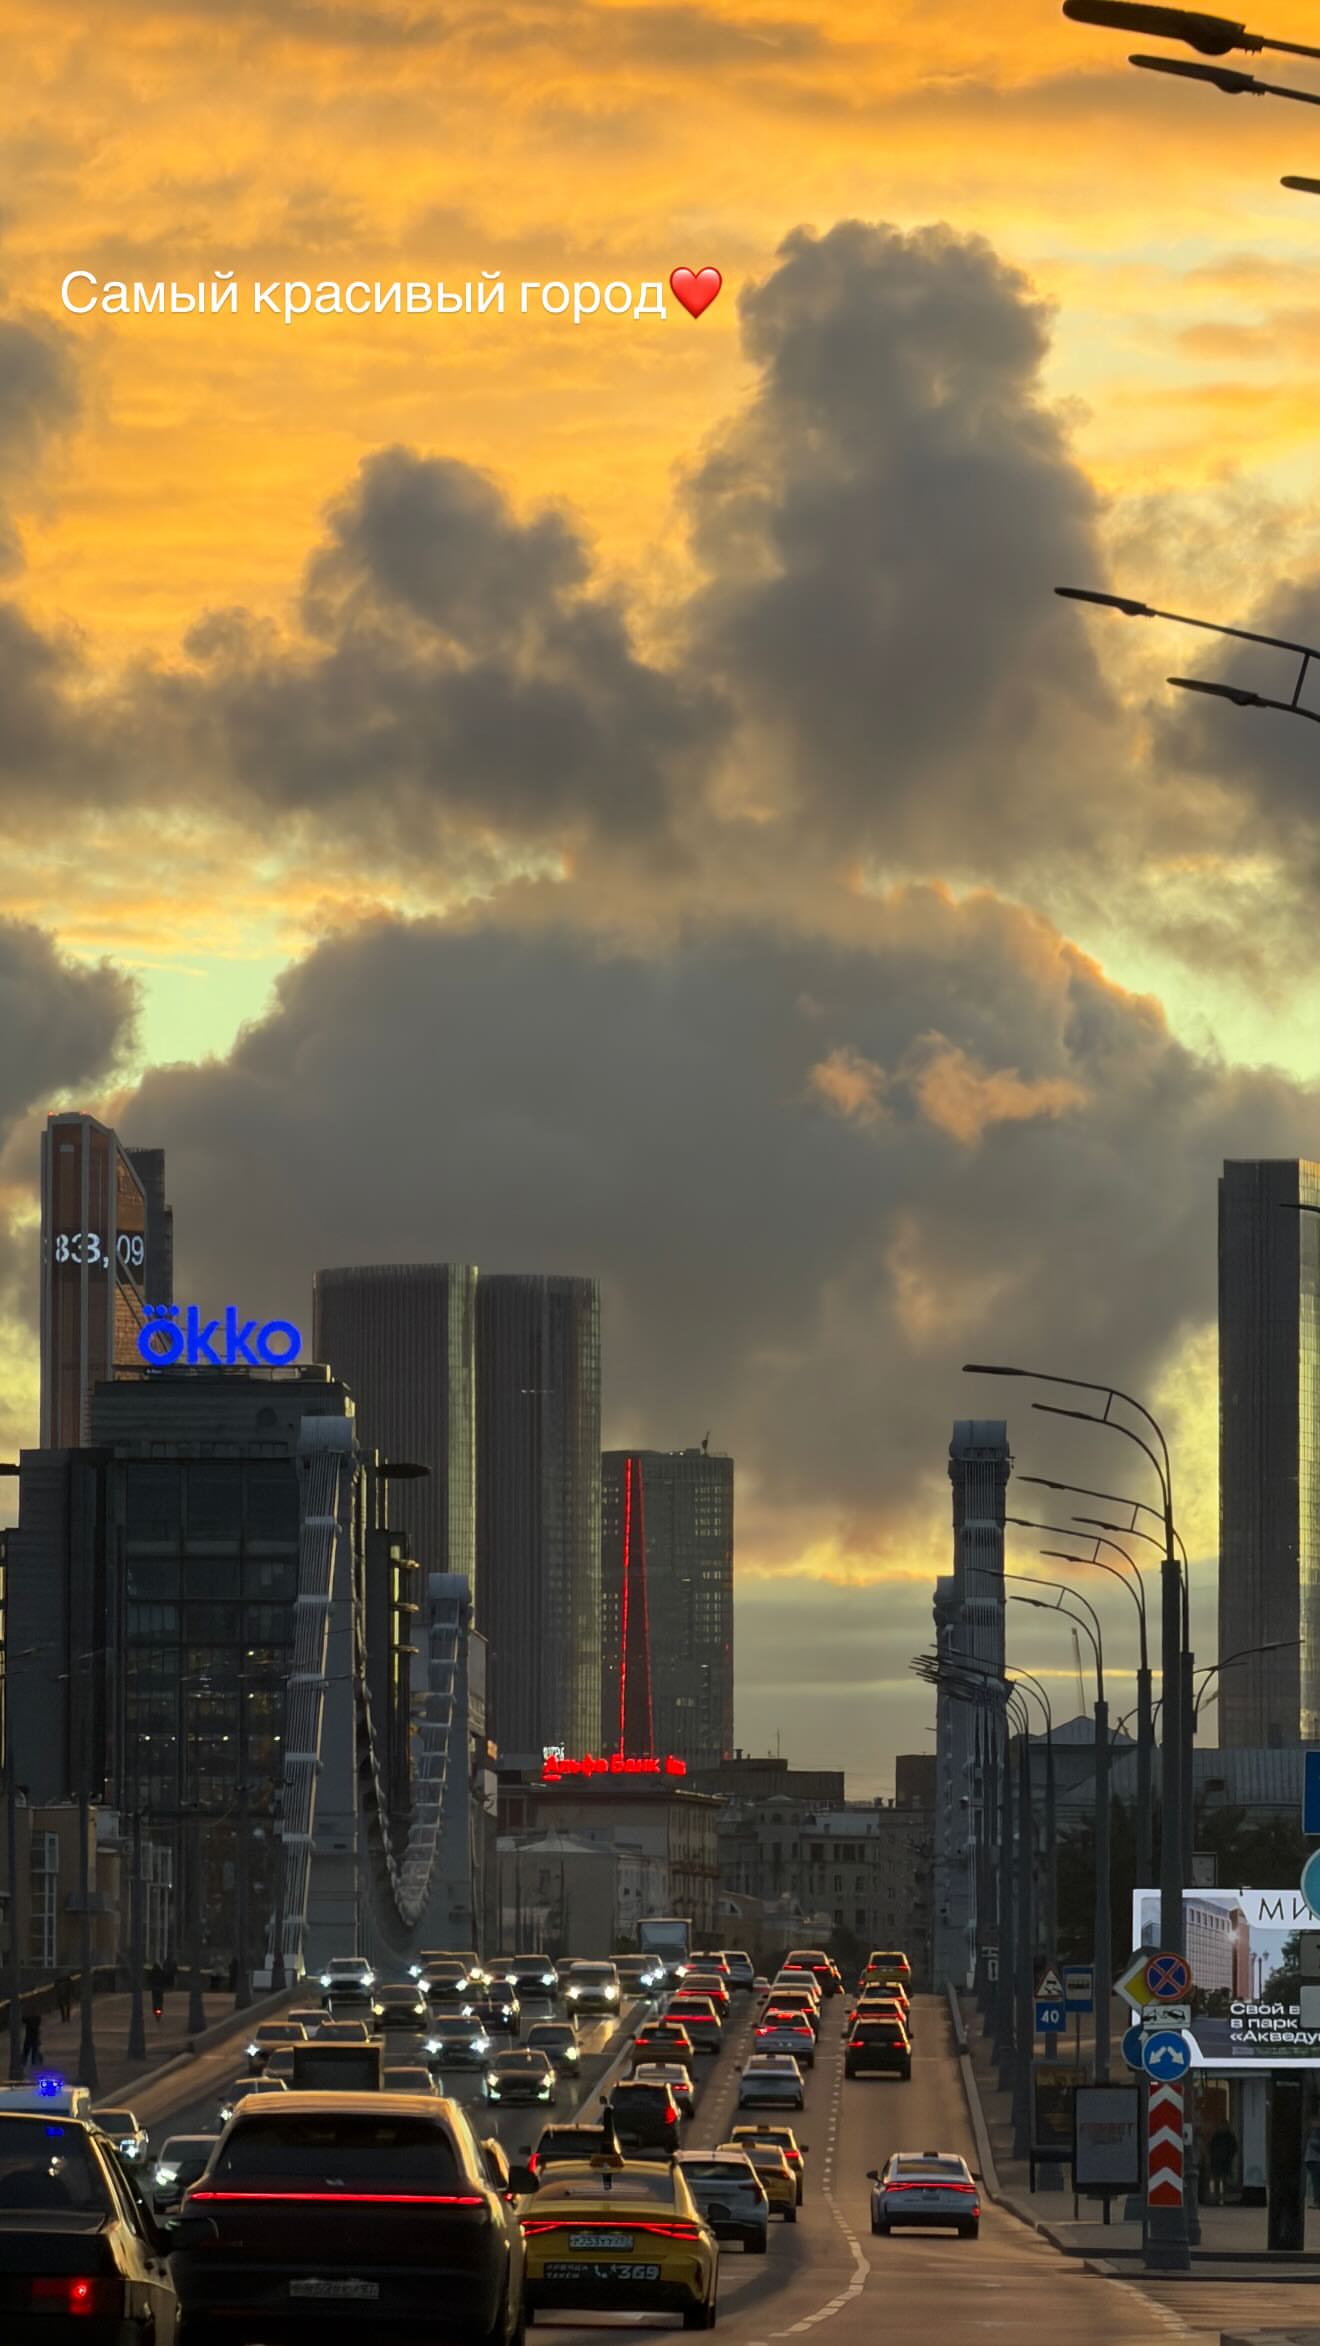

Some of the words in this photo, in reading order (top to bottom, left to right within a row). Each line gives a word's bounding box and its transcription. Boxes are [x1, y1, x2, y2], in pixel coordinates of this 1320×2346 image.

[1230, 2002, 1285, 2015] Свой
[1041, 2009, 1060, 2024] 40
[1230, 2019, 1243, 2029] в
[1248, 2019, 1298, 2031] парк
